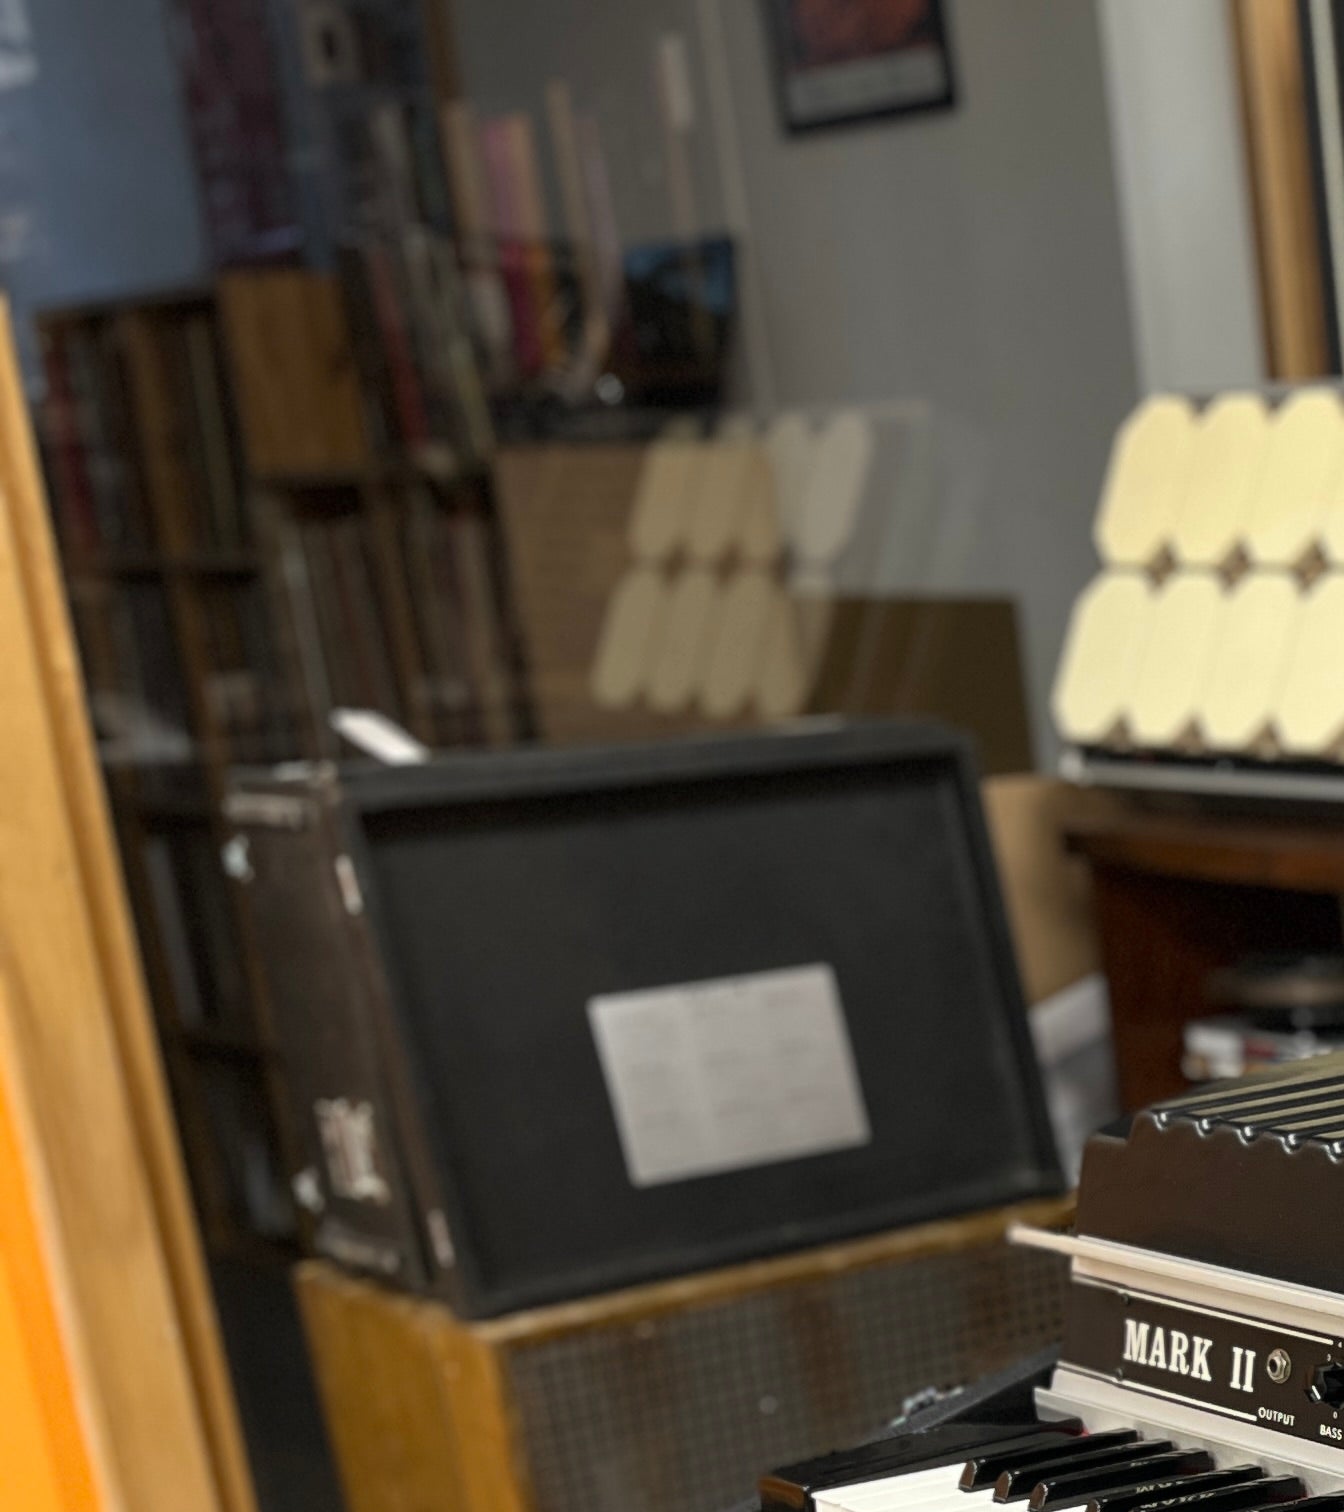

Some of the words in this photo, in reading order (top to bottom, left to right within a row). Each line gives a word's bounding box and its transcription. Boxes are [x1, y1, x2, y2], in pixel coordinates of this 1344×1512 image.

[1123, 1319, 1213, 1382] MARK
[1230, 1346, 1257, 1393] II
[1258, 1406, 1295, 1426] OUTPUT
[1320, 1424, 1342, 1440] BASS
